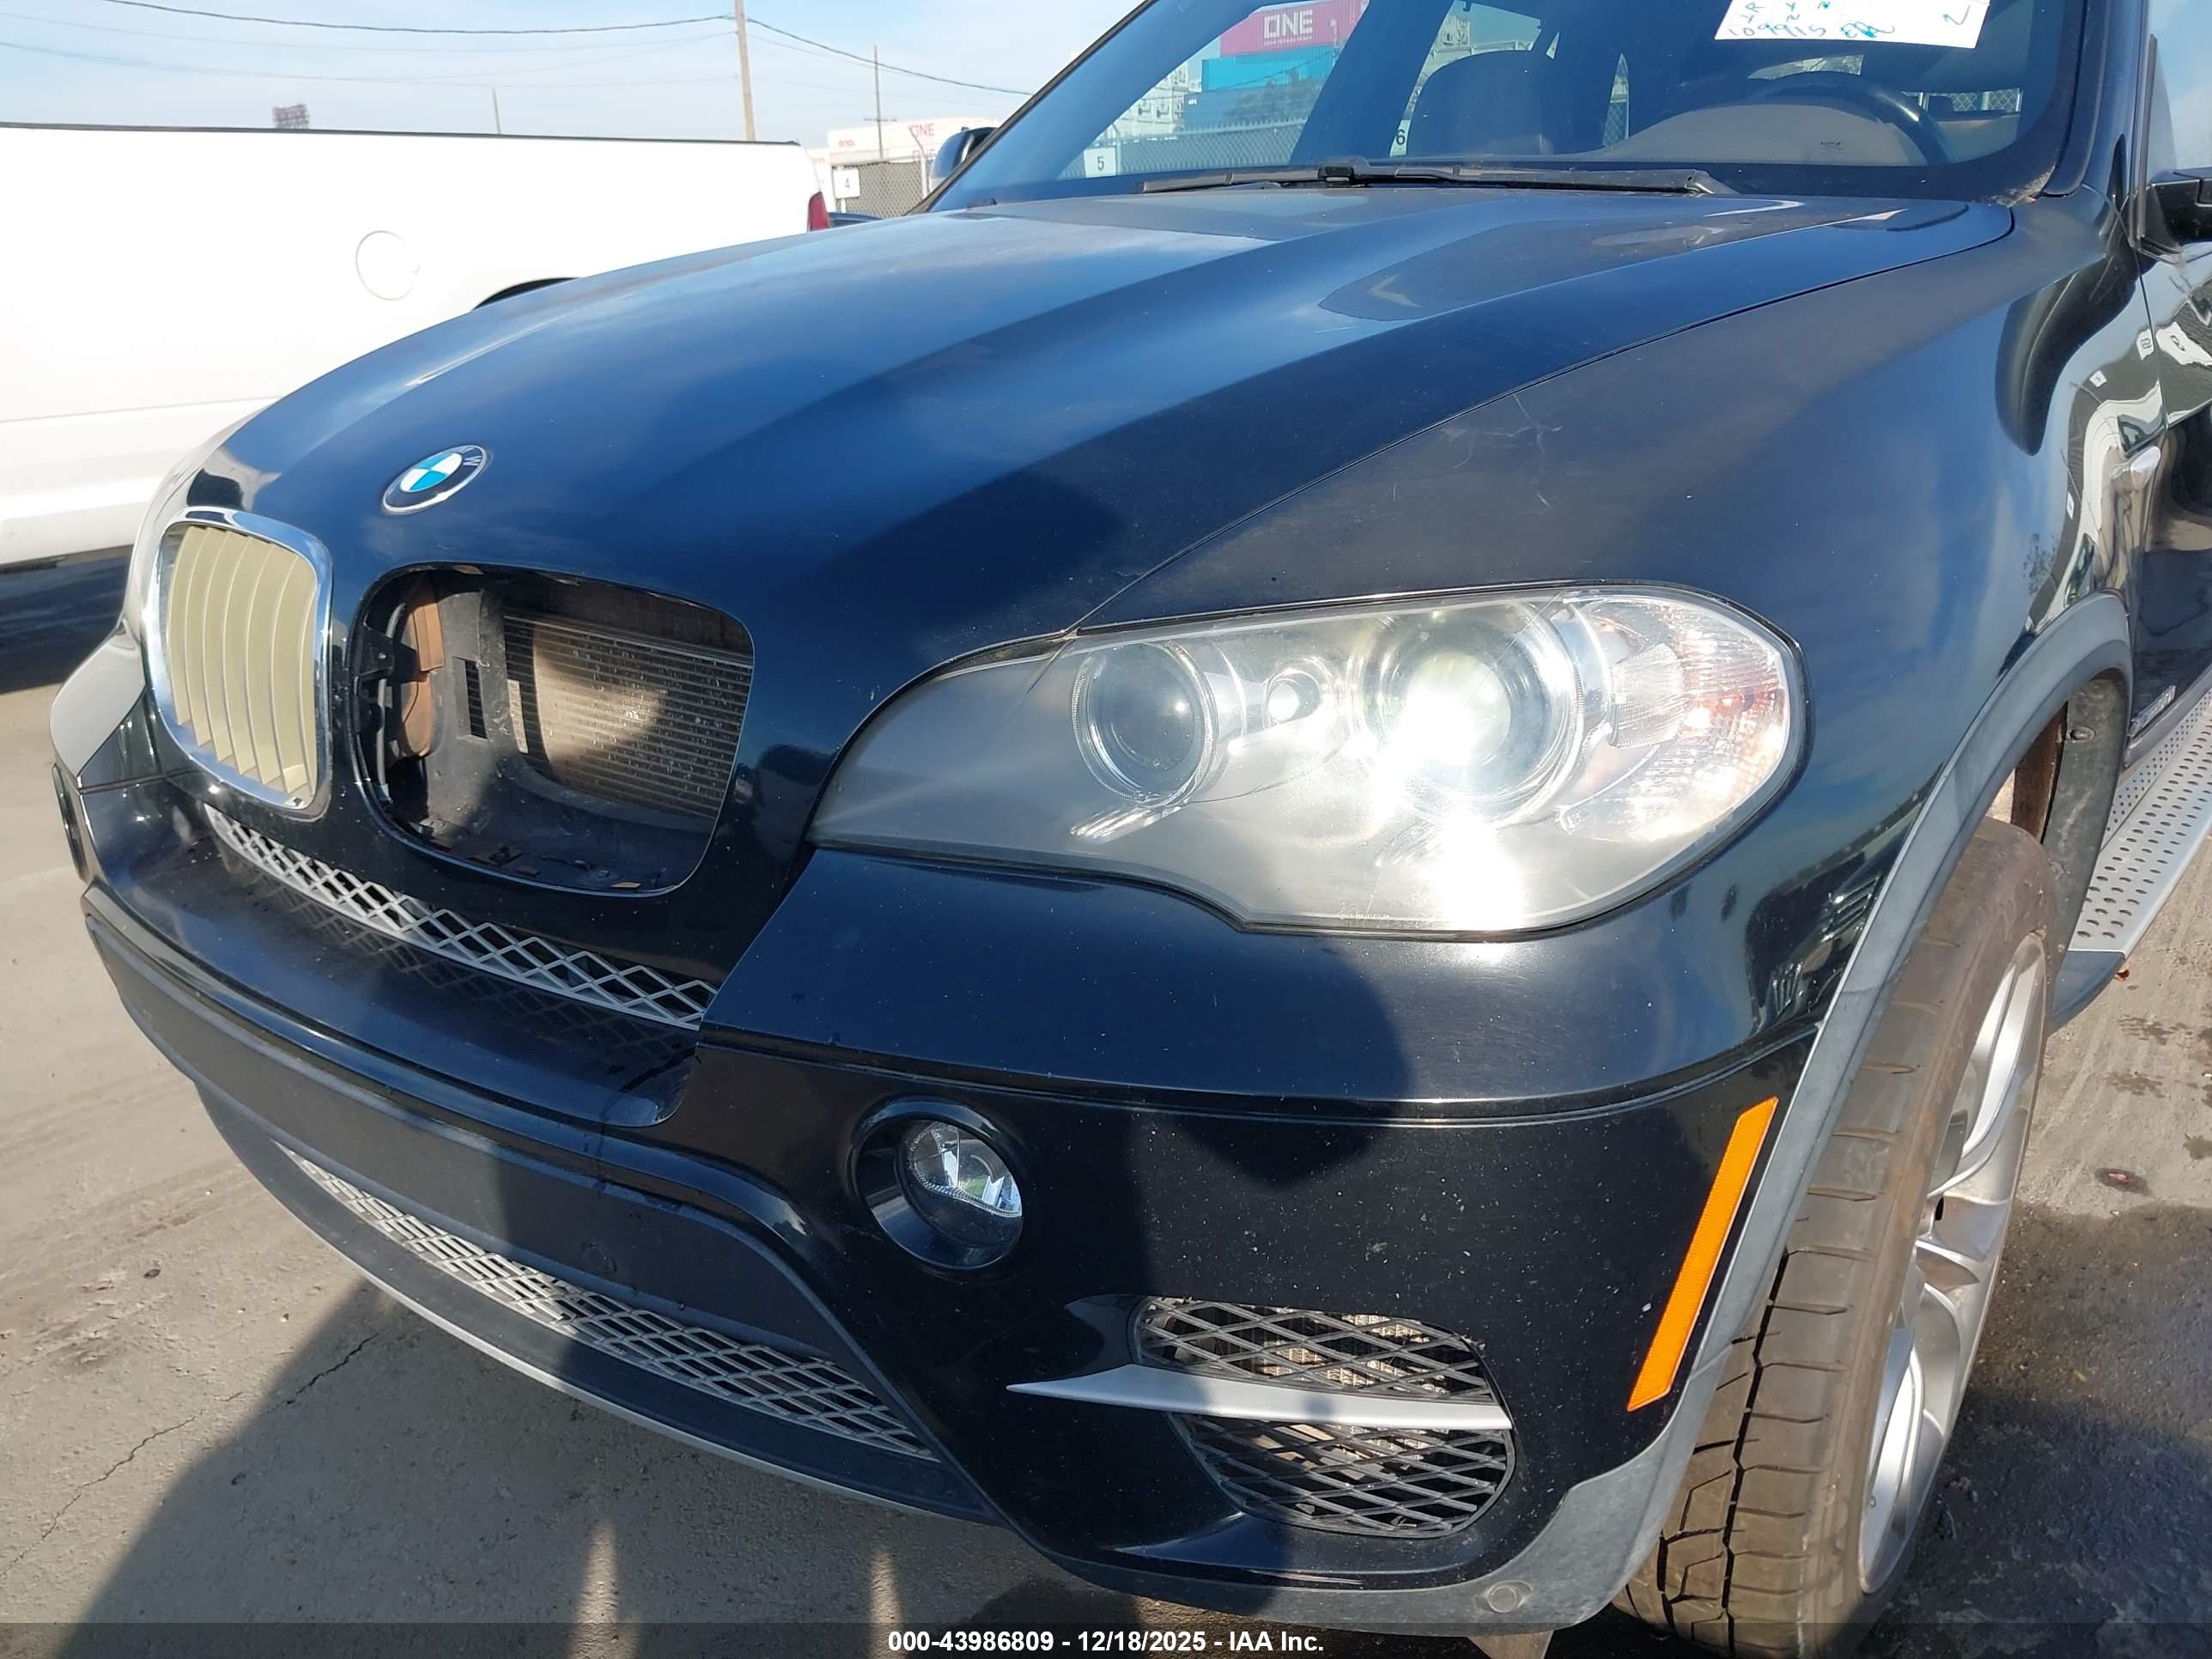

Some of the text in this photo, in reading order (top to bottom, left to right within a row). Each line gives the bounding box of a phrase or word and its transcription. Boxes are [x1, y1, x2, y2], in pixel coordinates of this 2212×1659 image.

[1263, 9, 1313, 40] ONE
[1396, 129, 1406, 146] 6
[1097, 155, 1105, 172] 5
[844, 177, 851, 191] 4
